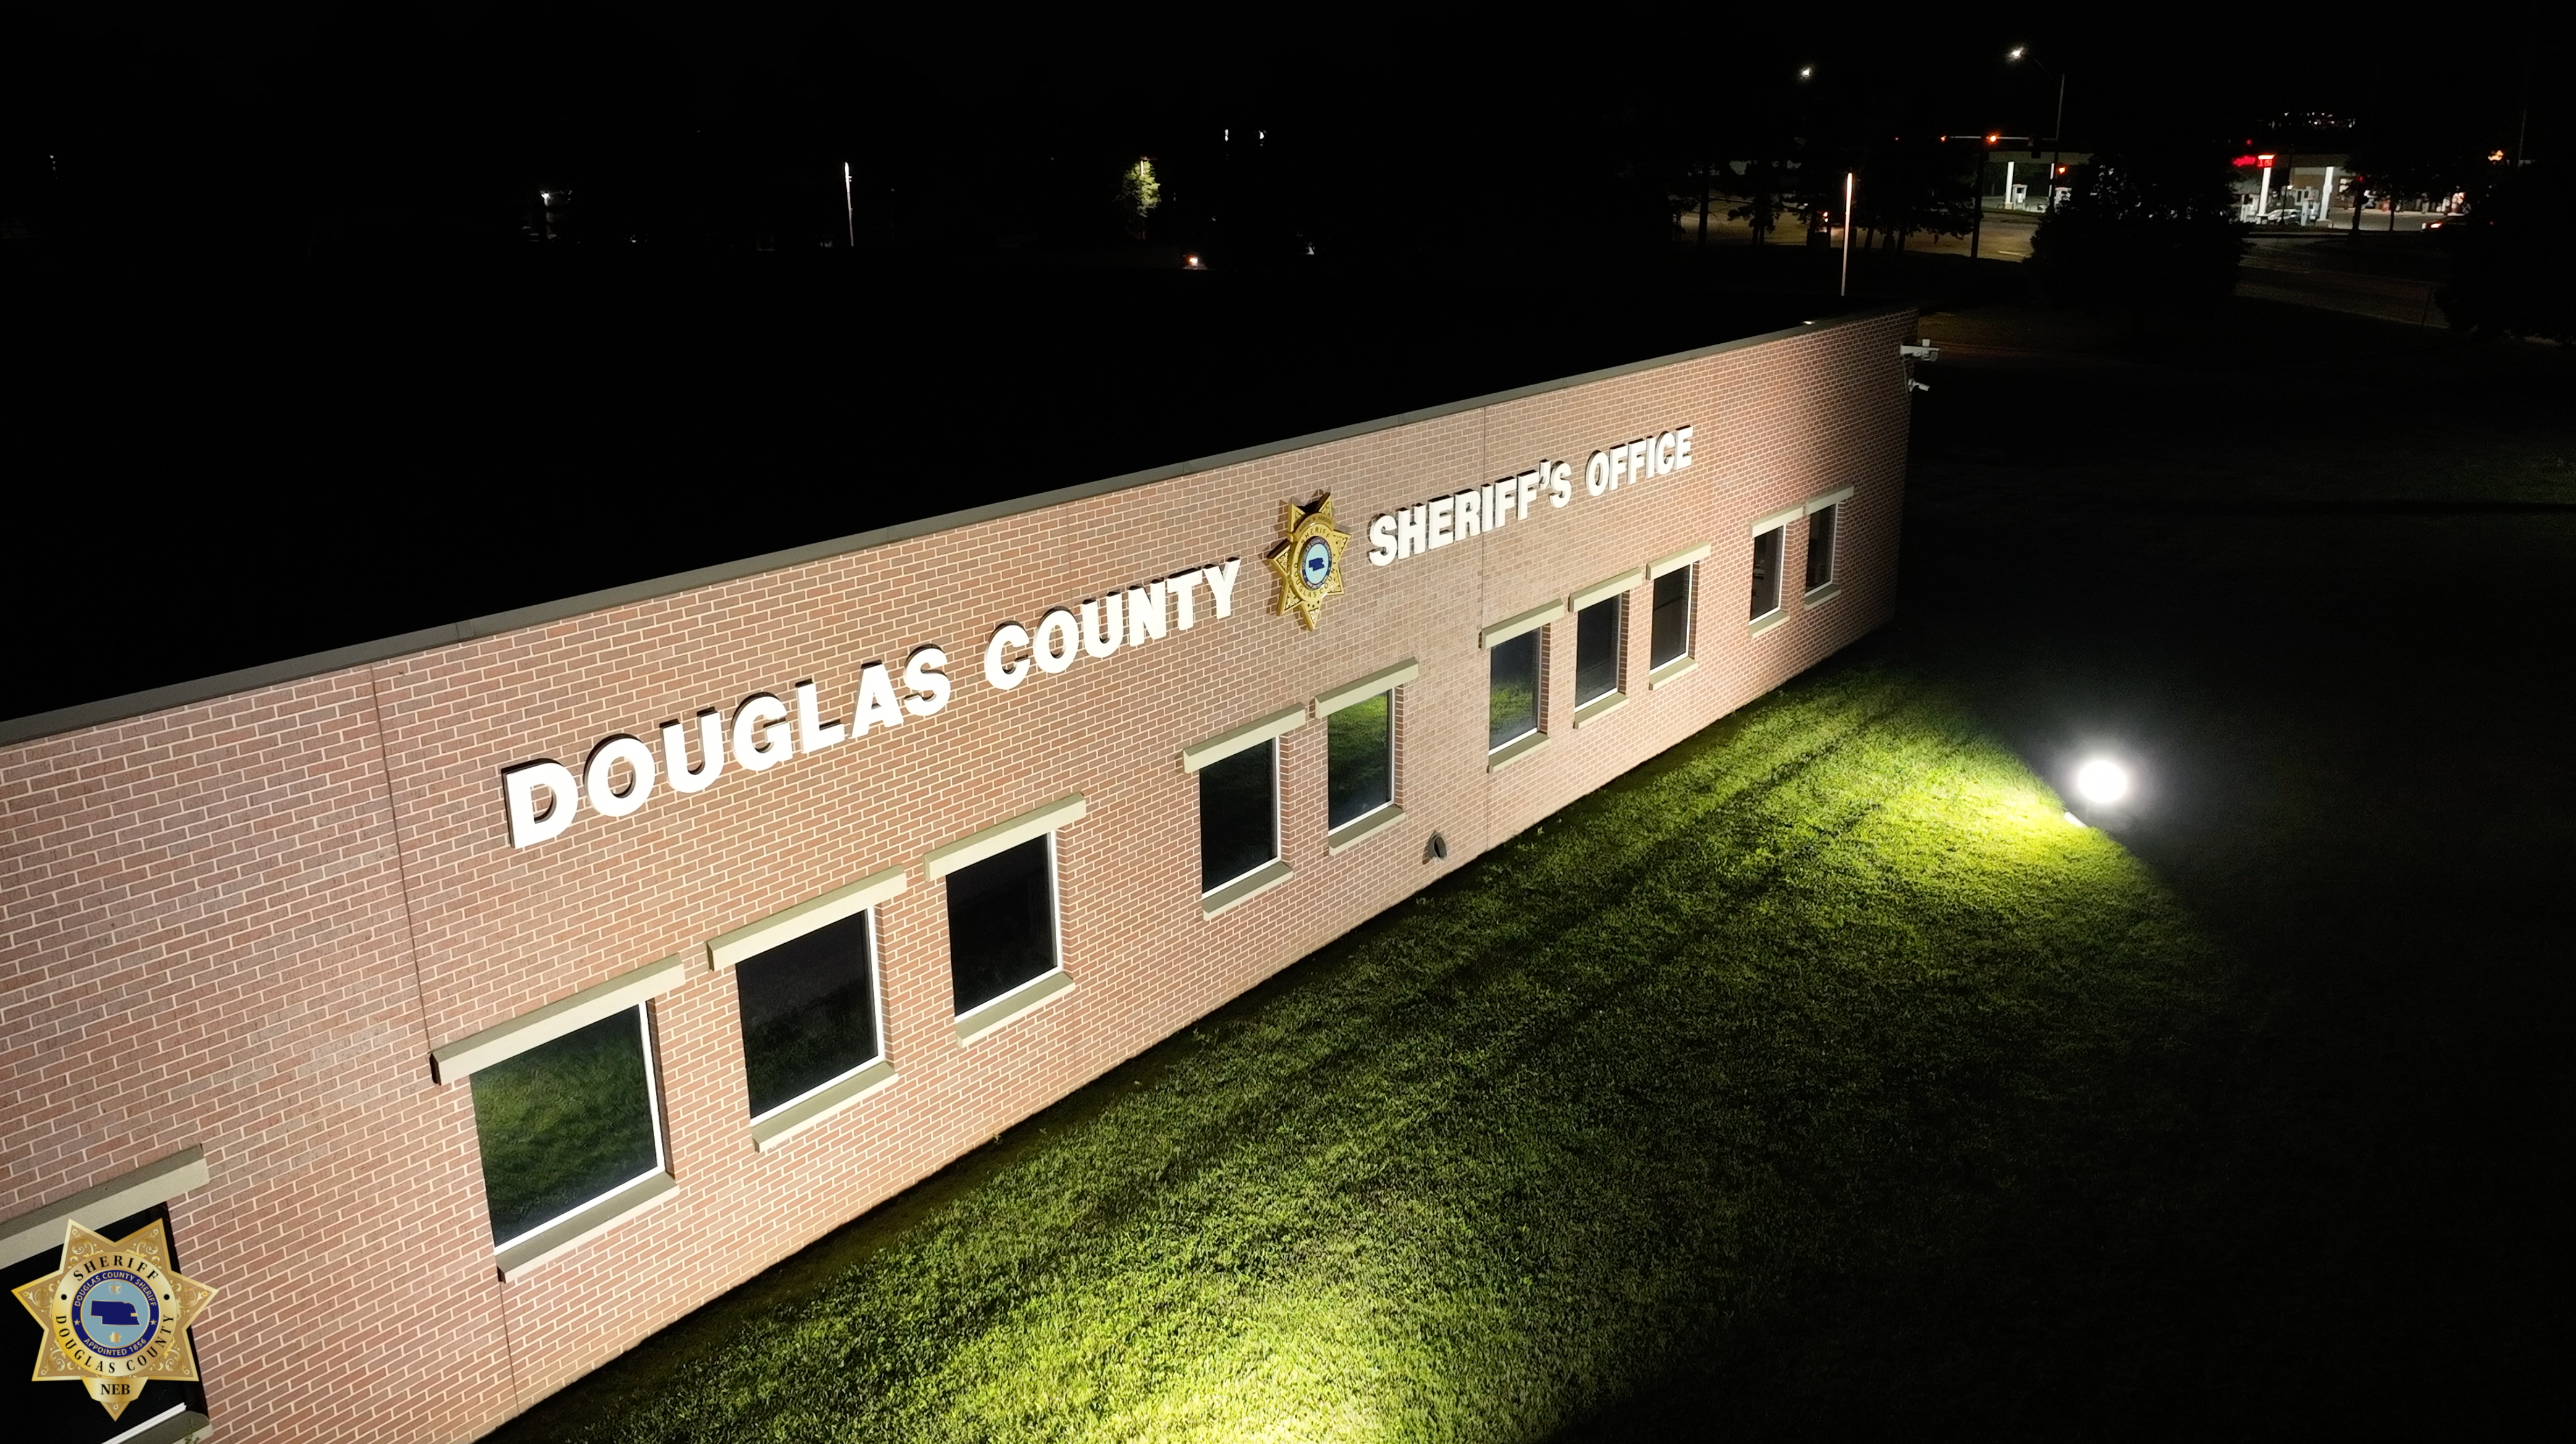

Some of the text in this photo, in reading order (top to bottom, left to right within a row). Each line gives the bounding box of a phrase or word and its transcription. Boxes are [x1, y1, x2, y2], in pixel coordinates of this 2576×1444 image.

[1301, 527, 1330, 543] SHERIFF
[1294, 563, 1317, 598] DOUGLAS
[501, 425, 1694, 850] DOUGLAS COUNTY SHERIFF'S OFFICE
